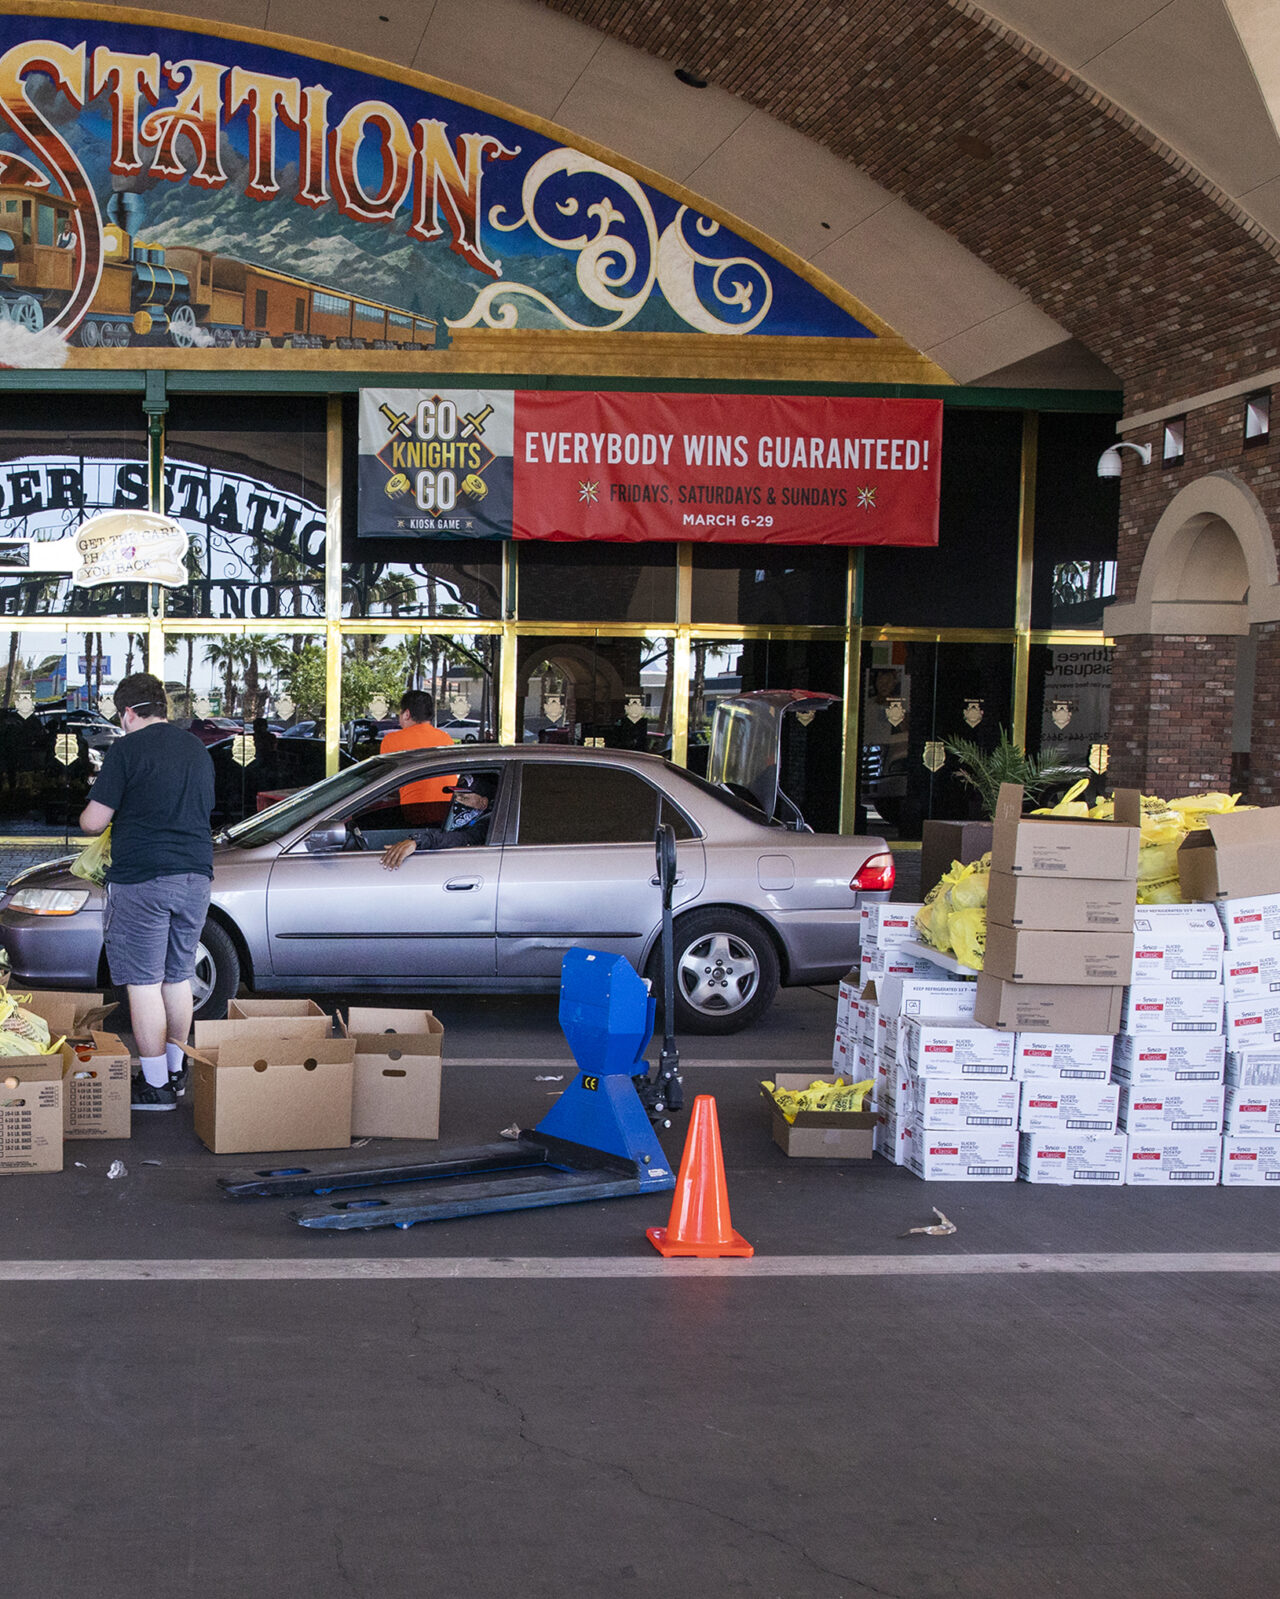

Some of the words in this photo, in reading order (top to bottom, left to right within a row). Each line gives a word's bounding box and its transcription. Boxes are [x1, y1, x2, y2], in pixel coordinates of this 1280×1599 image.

[416, 400, 457, 441] GO
[392, 442, 481, 469] KNIGHTS
[525, 431, 674, 465] EVERYBODY
[683, 435, 749, 467] WINS
[758, 436, 929, 471] GUARANTEED!
[415, 469, 457, 511] GO
[610, 484, 673, 506] FRIDAYS,
[678, 485, 762, 505] SATURDAYS
[766, 487, 777, 505] &
[781, 487, 848, 507] SUNDAYS
[410, 519, 435, 529] KIOSK
[438, 519, 460, 529] GAME
[683, 514, 736, 527] MARCH
[741, 515, 774, 528] 6-29
[79, 537, 106, 551] GET
[84, 565, 111, 578] YOU
